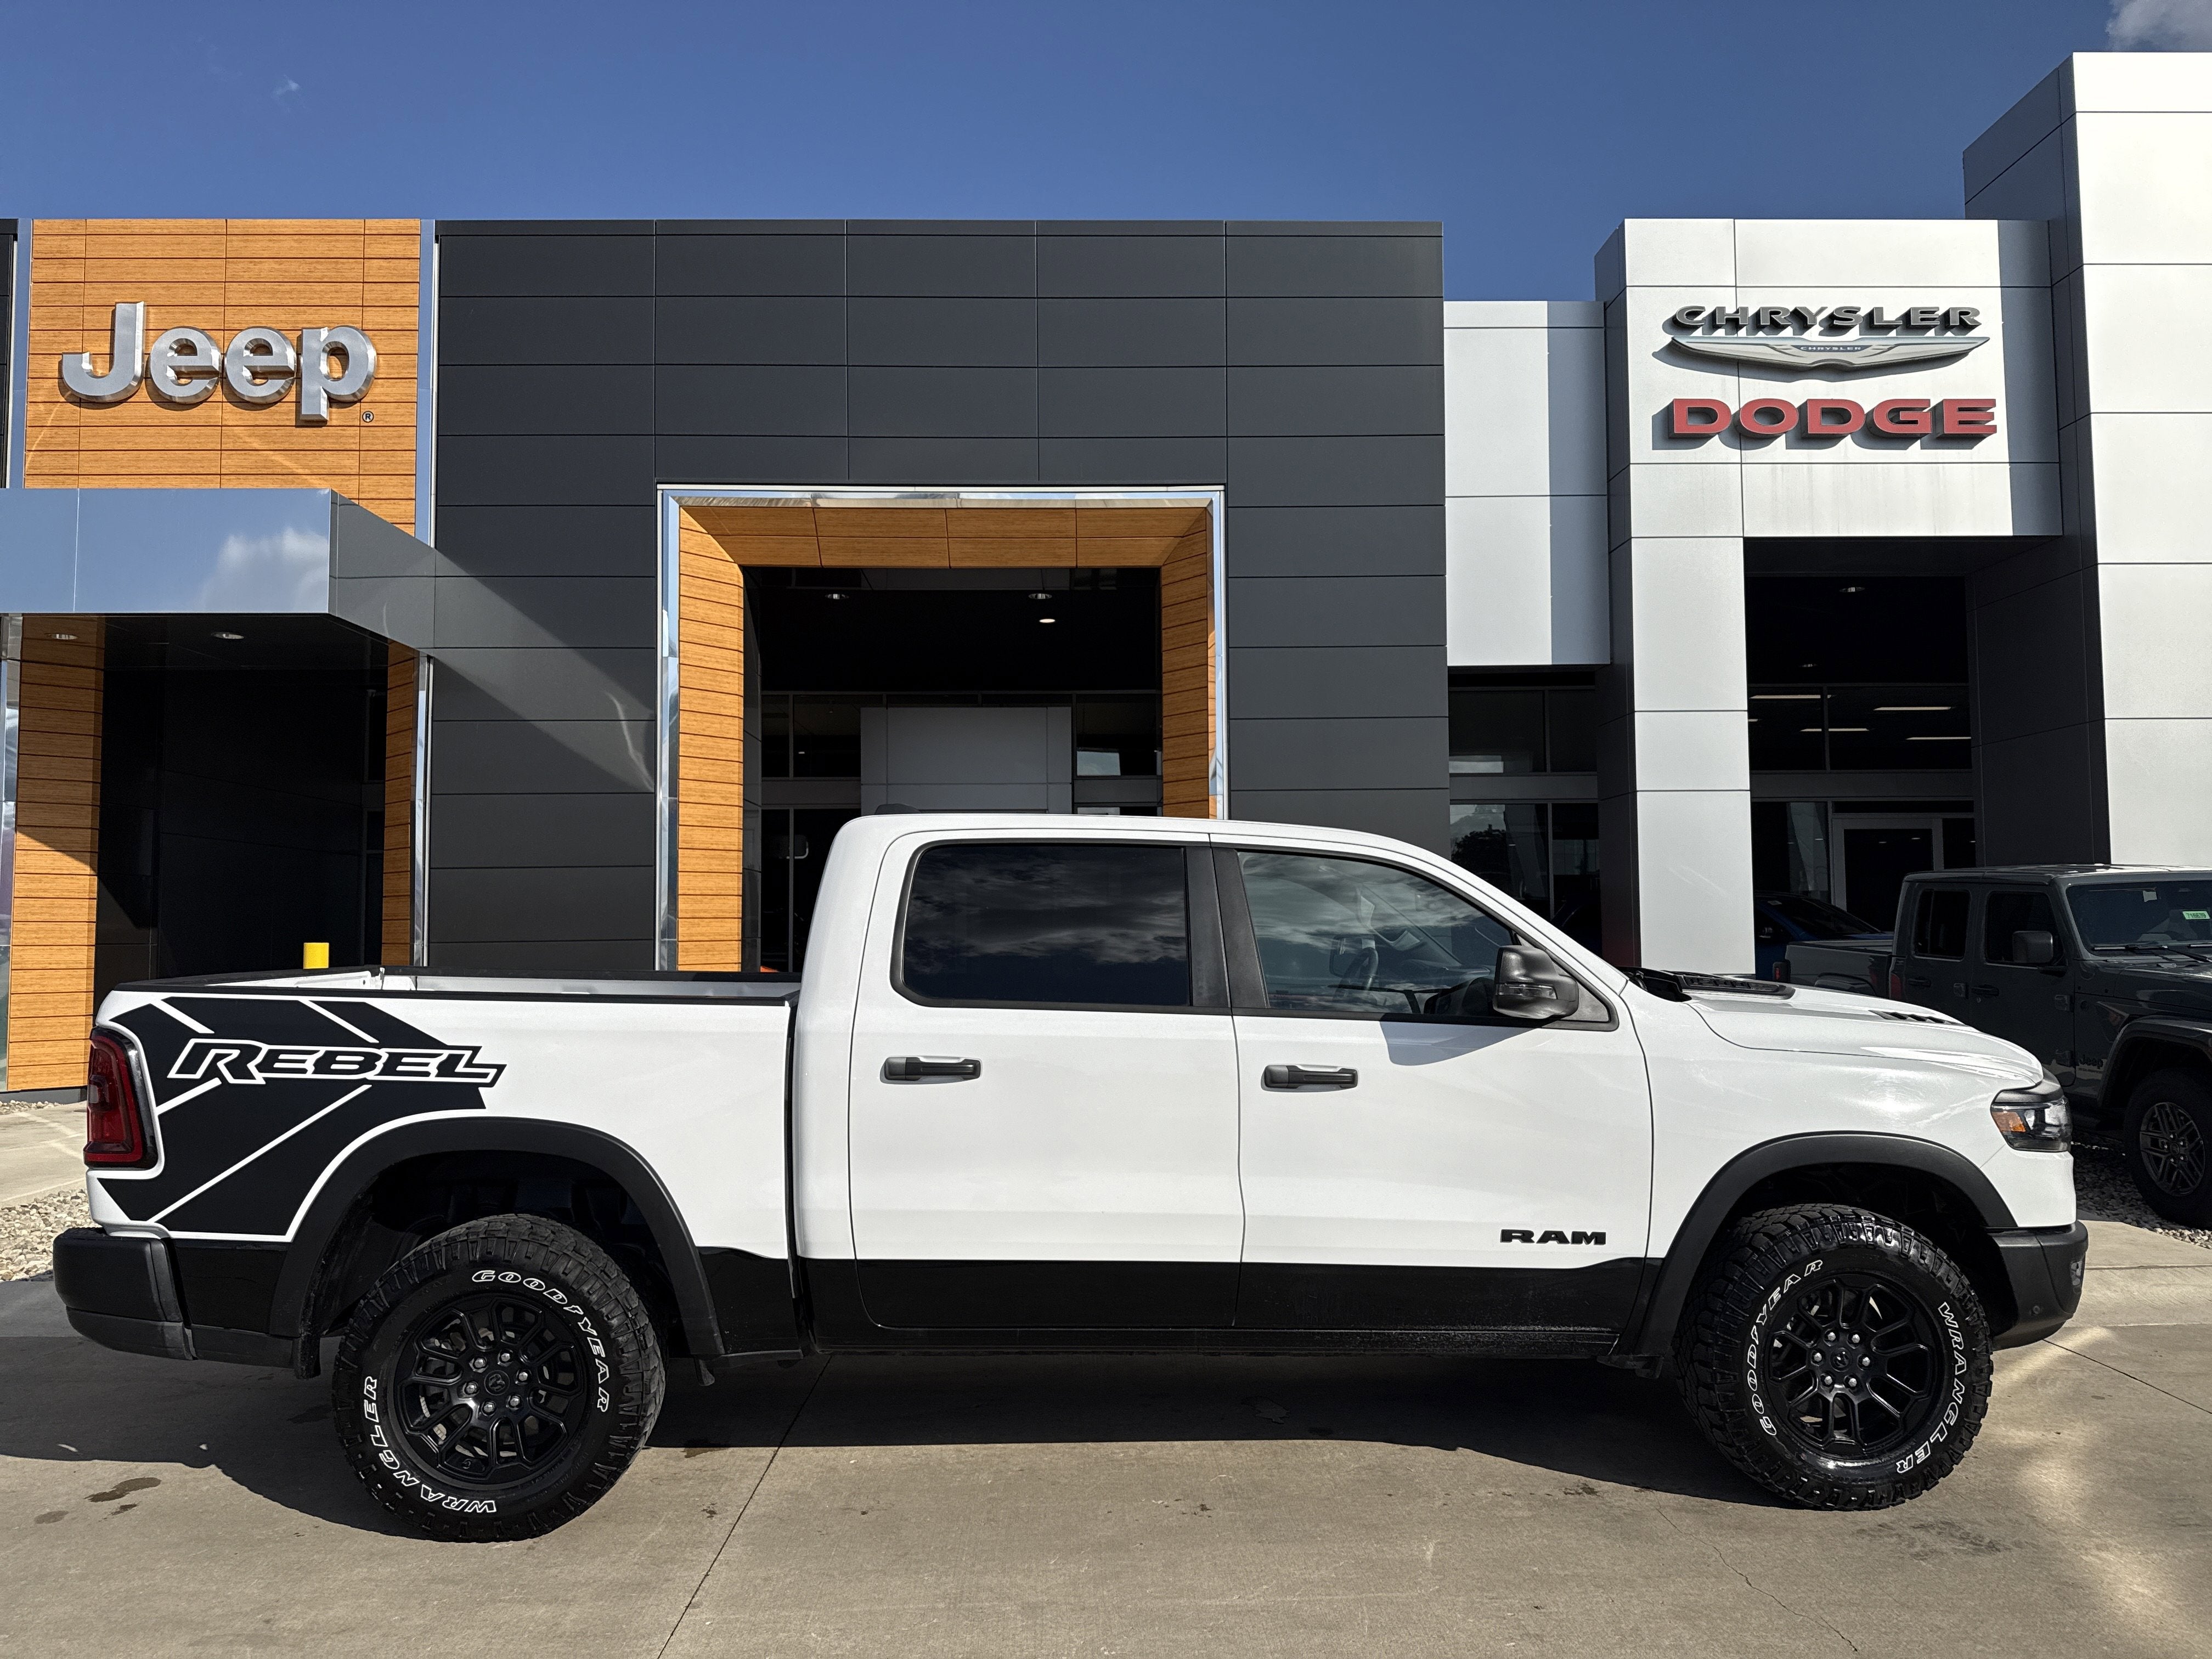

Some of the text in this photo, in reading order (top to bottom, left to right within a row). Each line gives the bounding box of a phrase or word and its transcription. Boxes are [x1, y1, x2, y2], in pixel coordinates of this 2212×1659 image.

[1674, 306, 1981, 327] CHRYSLER
[60, 301, 377, 421] Jeep
[1671, 399, 1997, 435] DODGE
[167, 1039, 507, 1085] REBEL
[2079, 1054, 2104, 1070] Jeep
[1500, 1229, 1606, 1245] RAM
[472, 1270, 610, 1412] GOODYEAR
[1747, 1260, 1822, 1435] GOODYEAR
[1896, 1302, 1967, 1473] WRANGLER
[364, 1376, 496, 1513] WRANGLER
